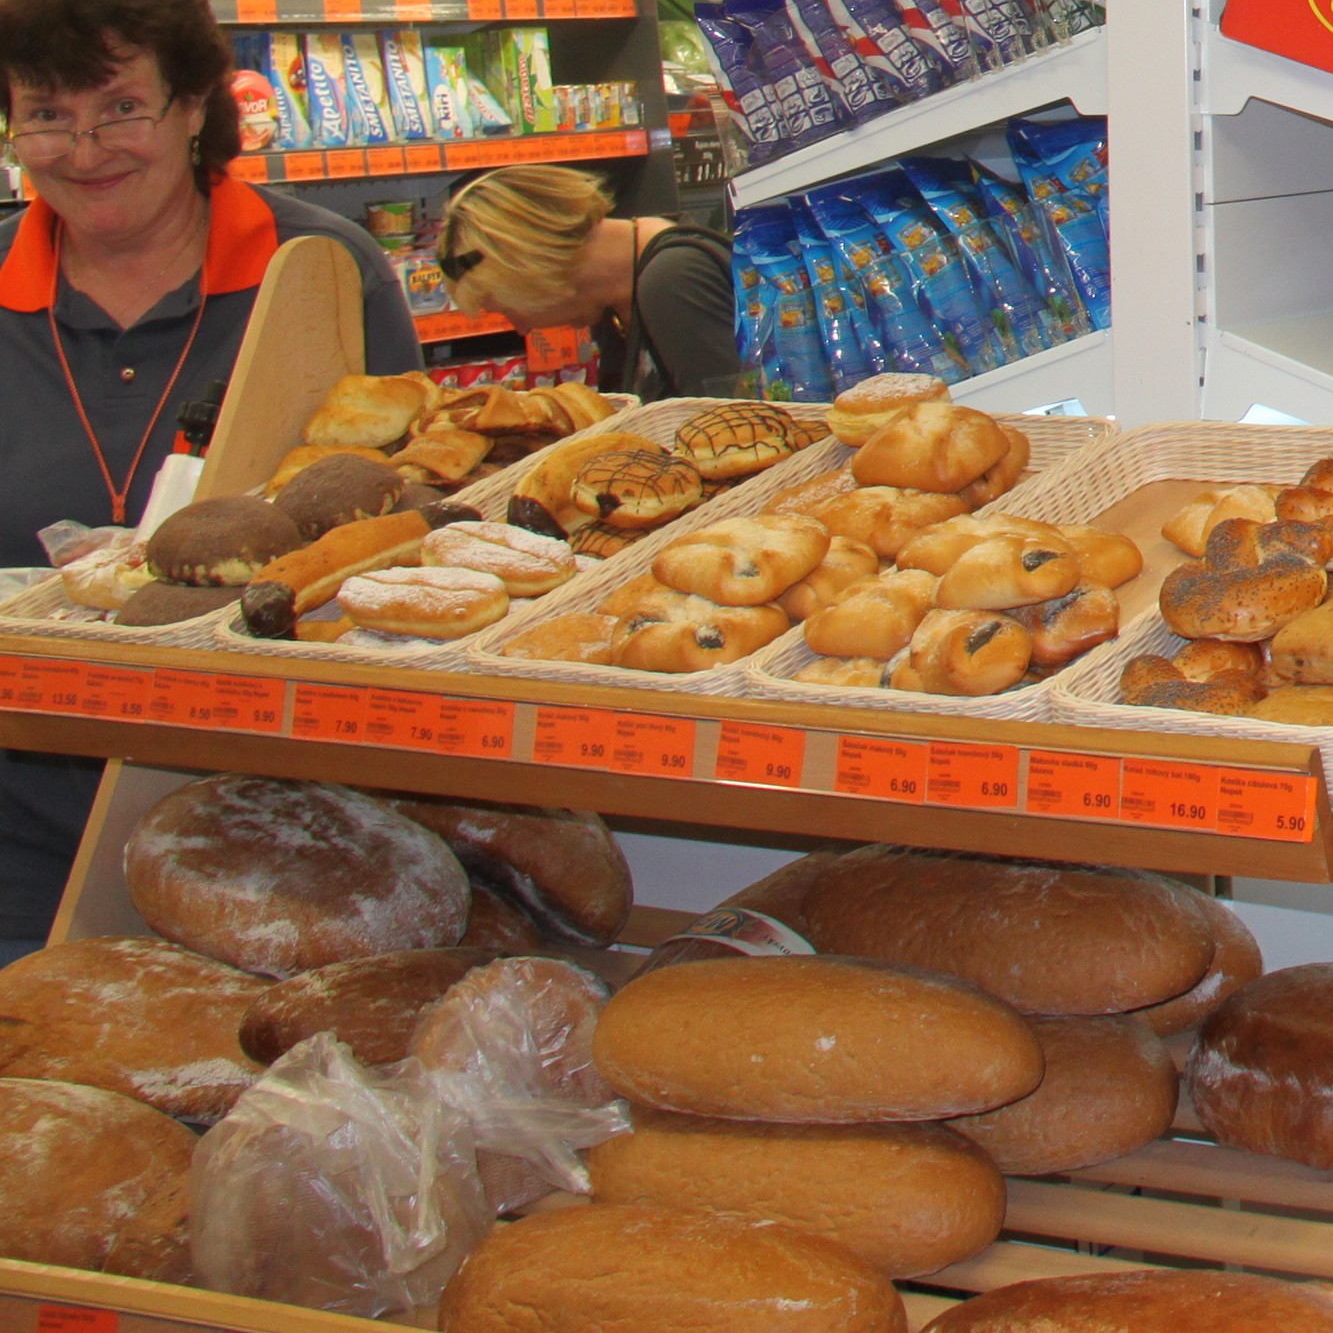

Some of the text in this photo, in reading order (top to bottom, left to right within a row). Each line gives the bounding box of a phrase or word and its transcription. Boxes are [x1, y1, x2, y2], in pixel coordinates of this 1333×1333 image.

[335, 719, 358, 734] 7.90
[481, 734, 505, 749] 6.90
[581, 743, 605, 757] 9.90
[661, 753, 686, 769] 9.90
[766, 763, 792, 780] 9.90
[890, 777, 917, 794] 6.90
[981, 781, 1008, 797] 6.90
[1083, 792, 1111, 808] 6.90
[1170, 802, 1206, 819] 16.90
[1276, 815, 1306, 832] 5.90
